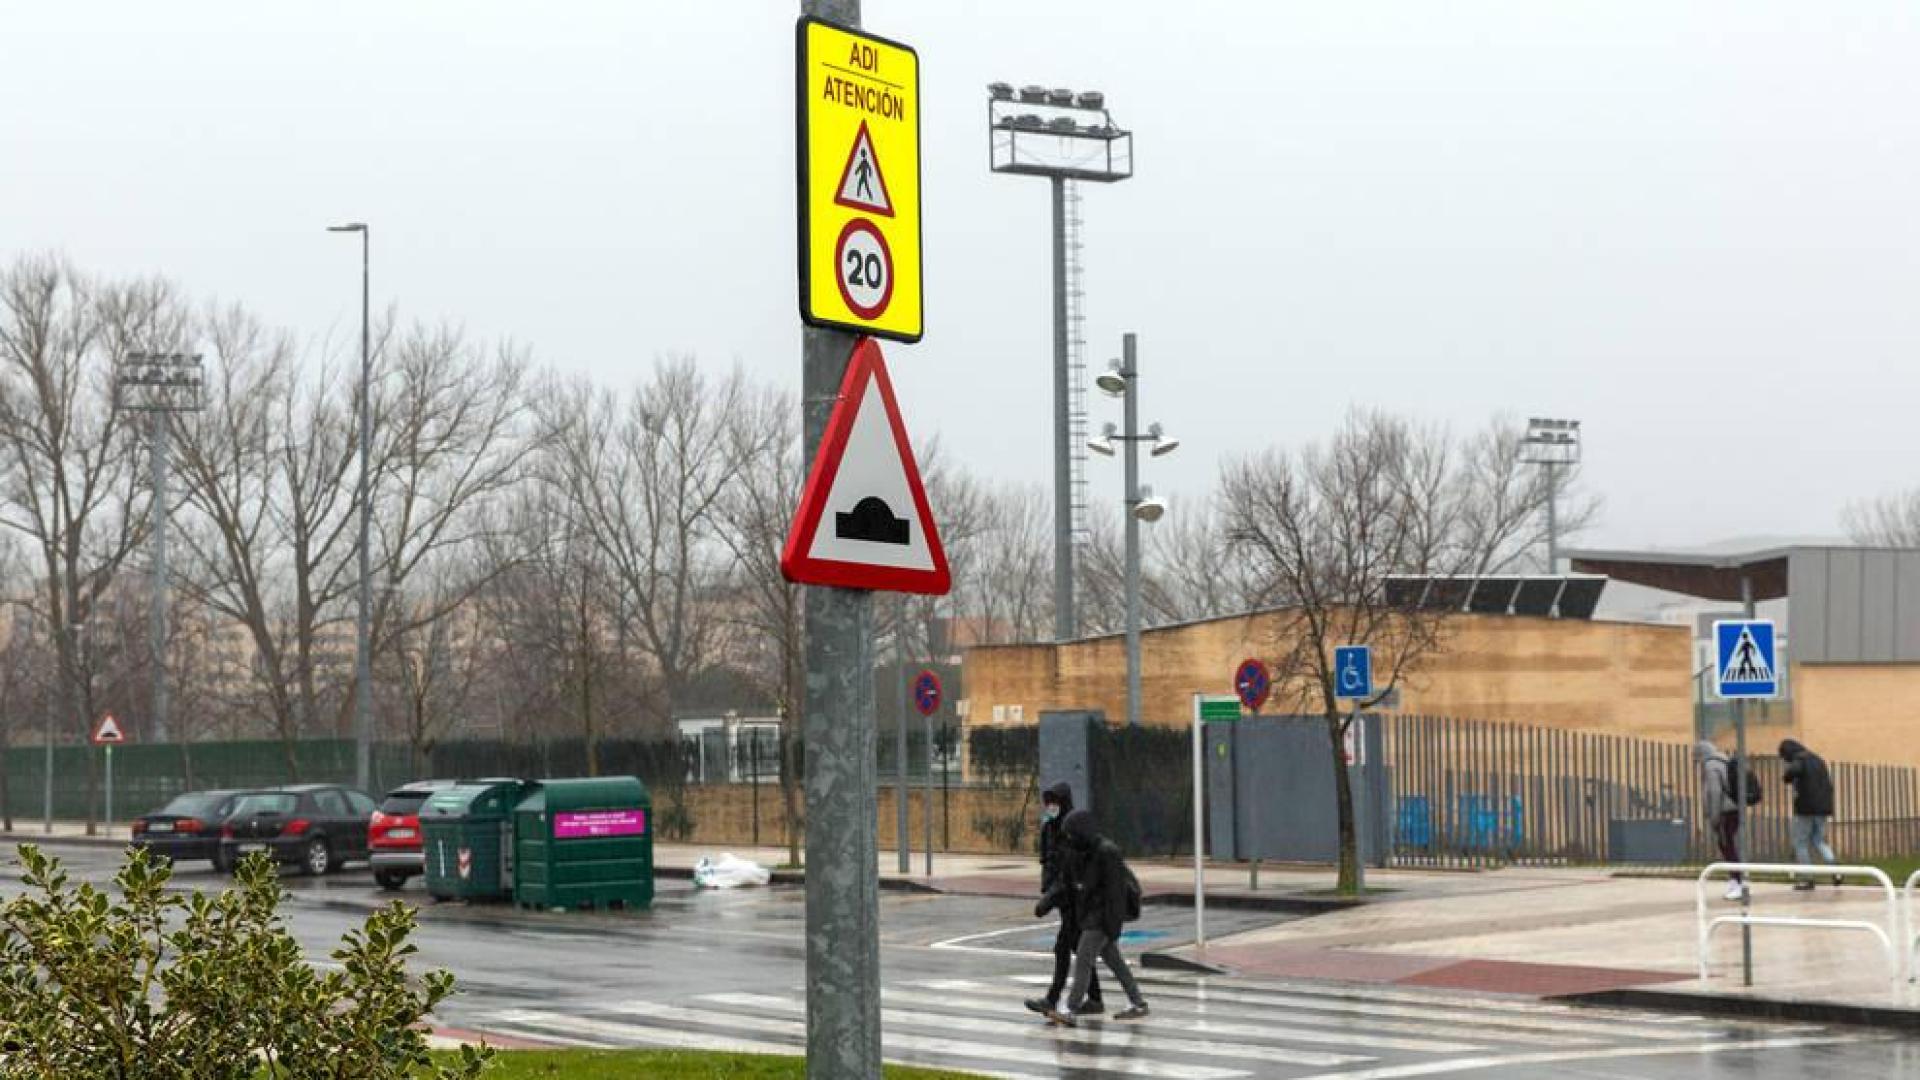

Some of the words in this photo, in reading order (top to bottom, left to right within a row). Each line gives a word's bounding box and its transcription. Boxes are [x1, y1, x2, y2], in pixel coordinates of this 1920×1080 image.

[849, 42, 878, 73] ADI
[823, 74, 904, 122] ATENCIÓN
[847, 249, 882, 289] 20
